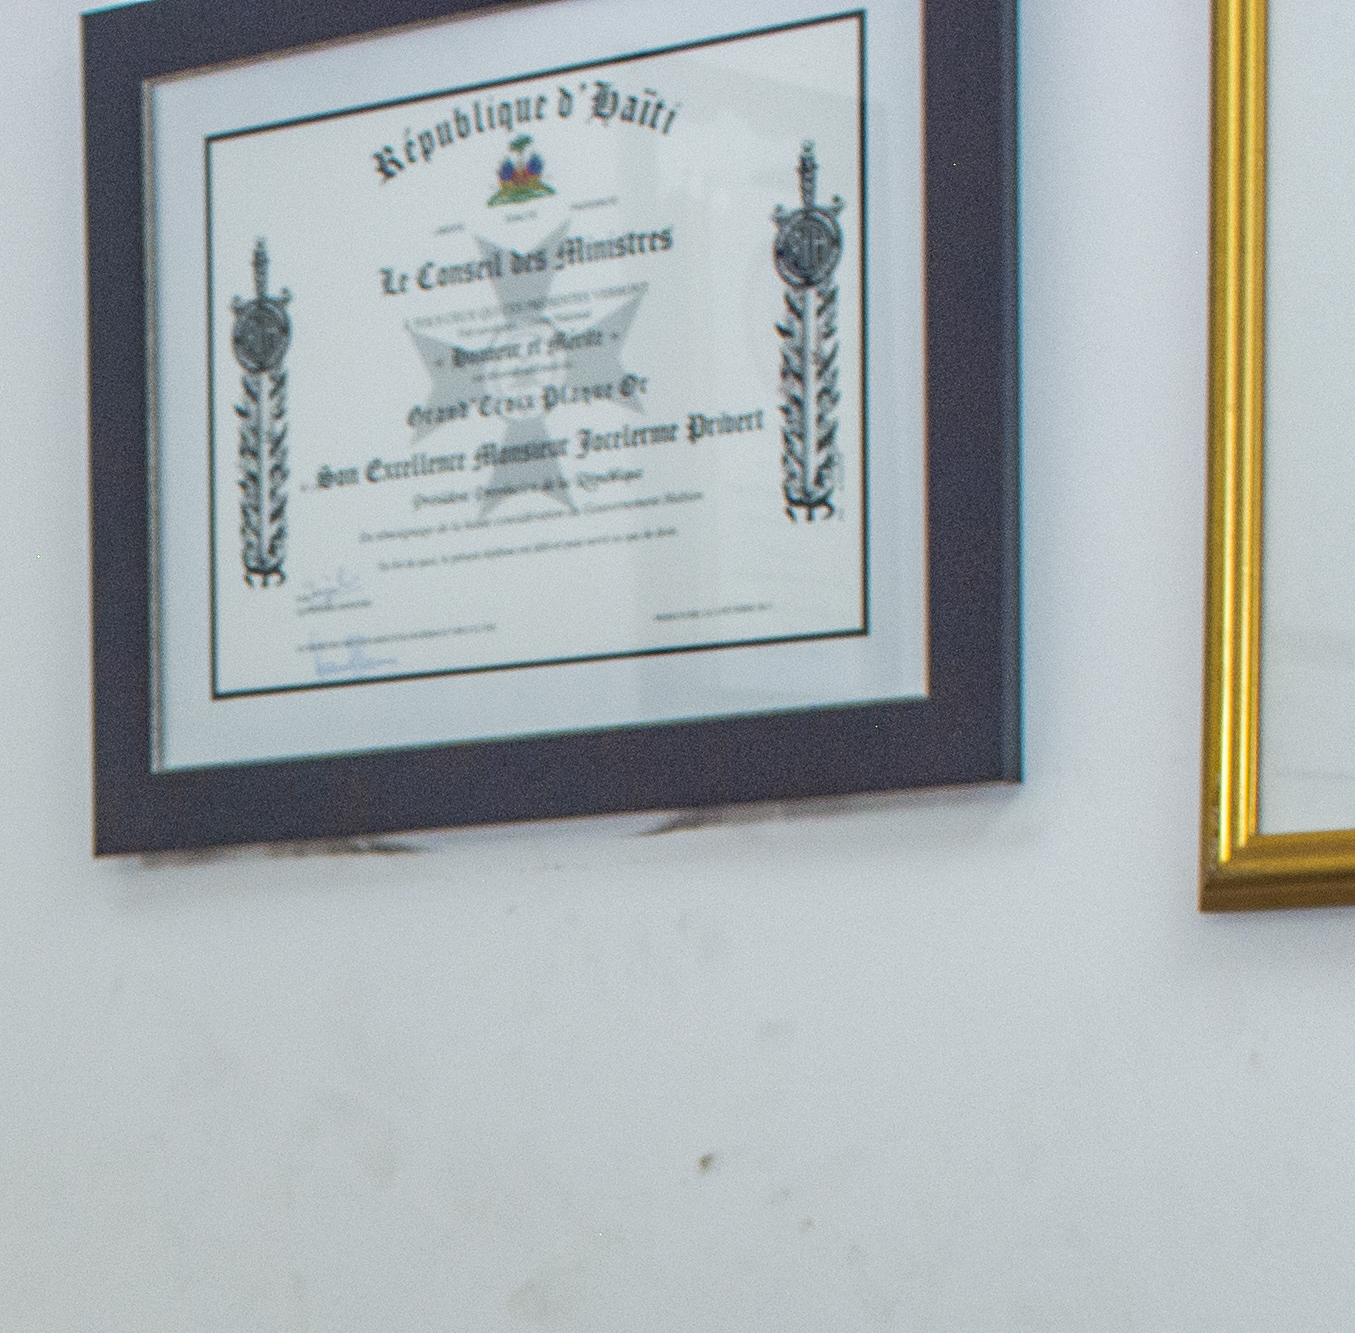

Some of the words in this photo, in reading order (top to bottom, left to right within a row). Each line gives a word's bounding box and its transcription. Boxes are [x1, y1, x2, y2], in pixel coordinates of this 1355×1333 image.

[372, 94, 547, 184] République
[556, 80, 680, 134] d'Haïti
[380, 266, 409, 296] Le
[417, 249, 503, 291] Conseil
[510, 247, 547, 275] des
[553, 225, 673, 270] Ministres
[365, 453, 466, 484] Excellence
[473, 439, 567, 472] Monsieur
[575, 424, 678, 459] Jocelerme
[686, 409, 763, 444] Privert
